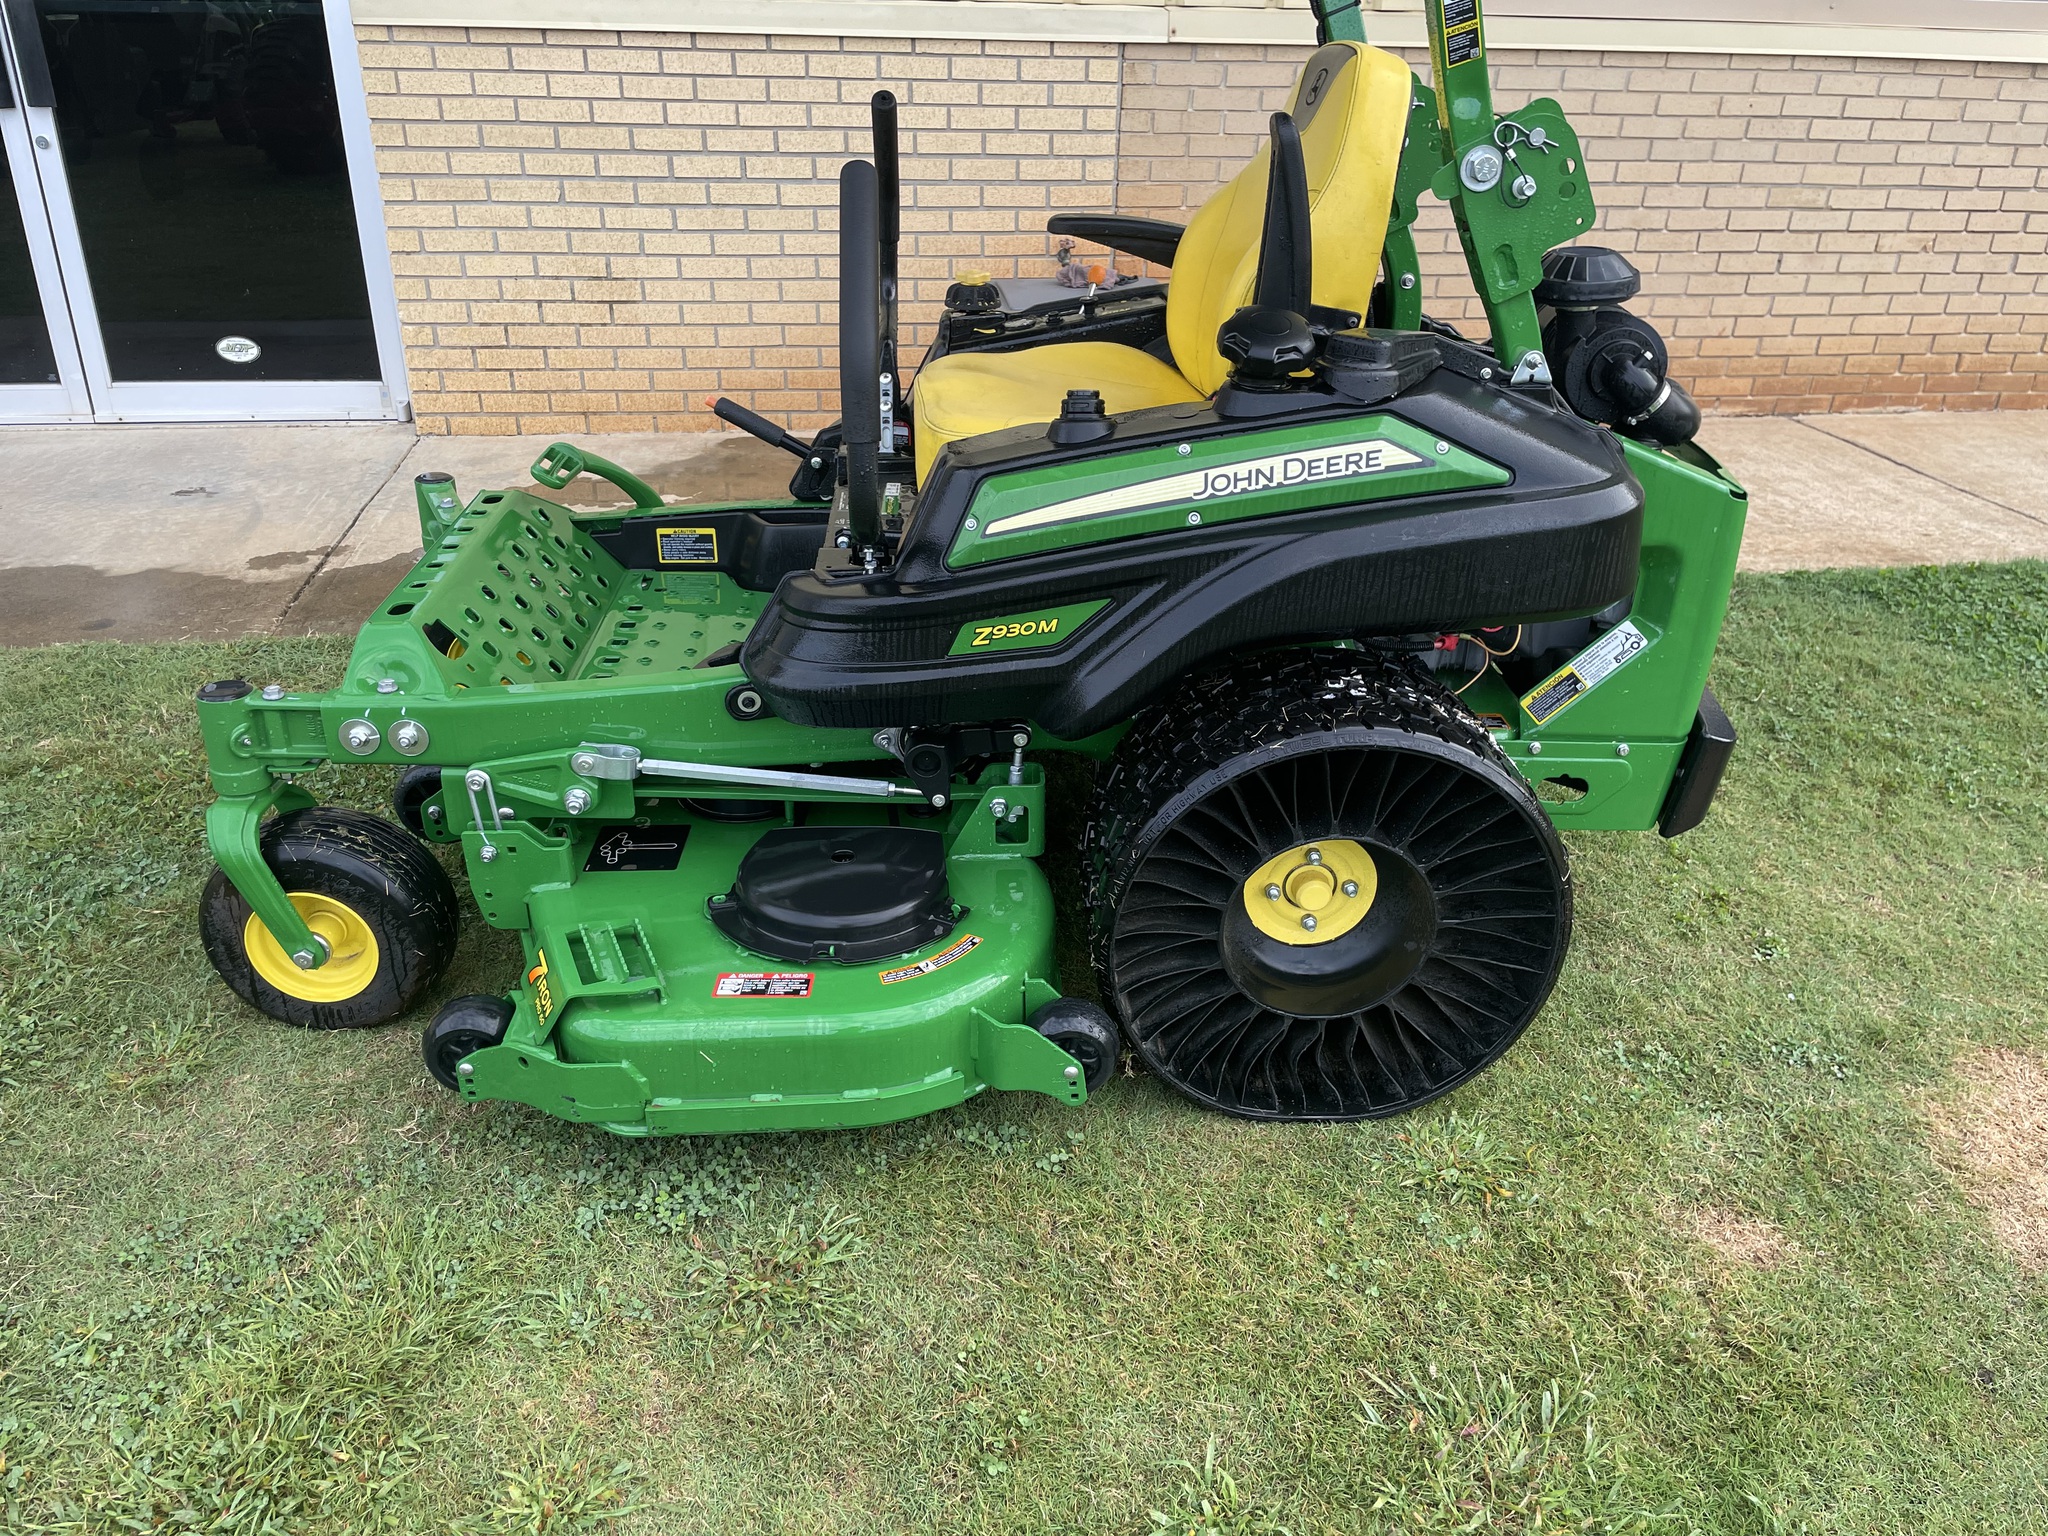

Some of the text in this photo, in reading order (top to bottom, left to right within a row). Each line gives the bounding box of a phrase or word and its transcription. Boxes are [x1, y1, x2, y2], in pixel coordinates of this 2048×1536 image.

[1451, 21, 1478, 34] ATENCIÓN
[1193, 449, 1383, 497] JOHN DEERE
[971, 618, 1059, 647] Z930M
[1536, 673, 1564, 698] ATENCIÓN
[1142, 770, 1228, 845] NOT FOR HIGHWAY USE
